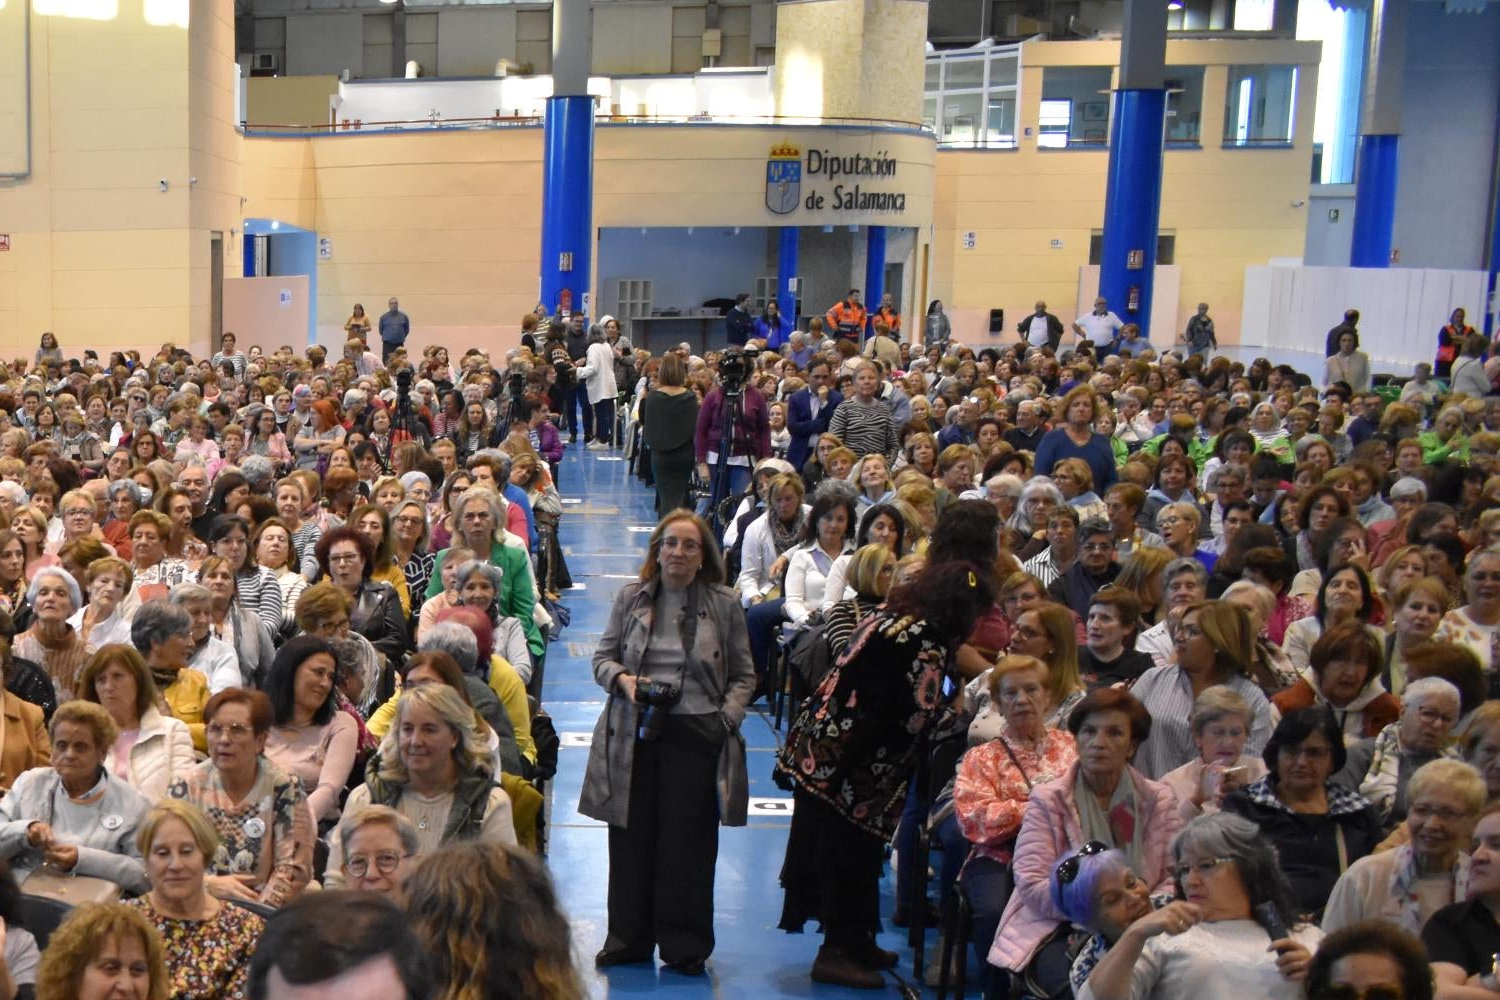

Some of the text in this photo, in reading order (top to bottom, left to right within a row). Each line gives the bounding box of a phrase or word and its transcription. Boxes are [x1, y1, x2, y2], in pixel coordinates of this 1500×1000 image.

[806, 149, 896, 180] Diputación
[805, 185, 906, 211] de Salamanca
